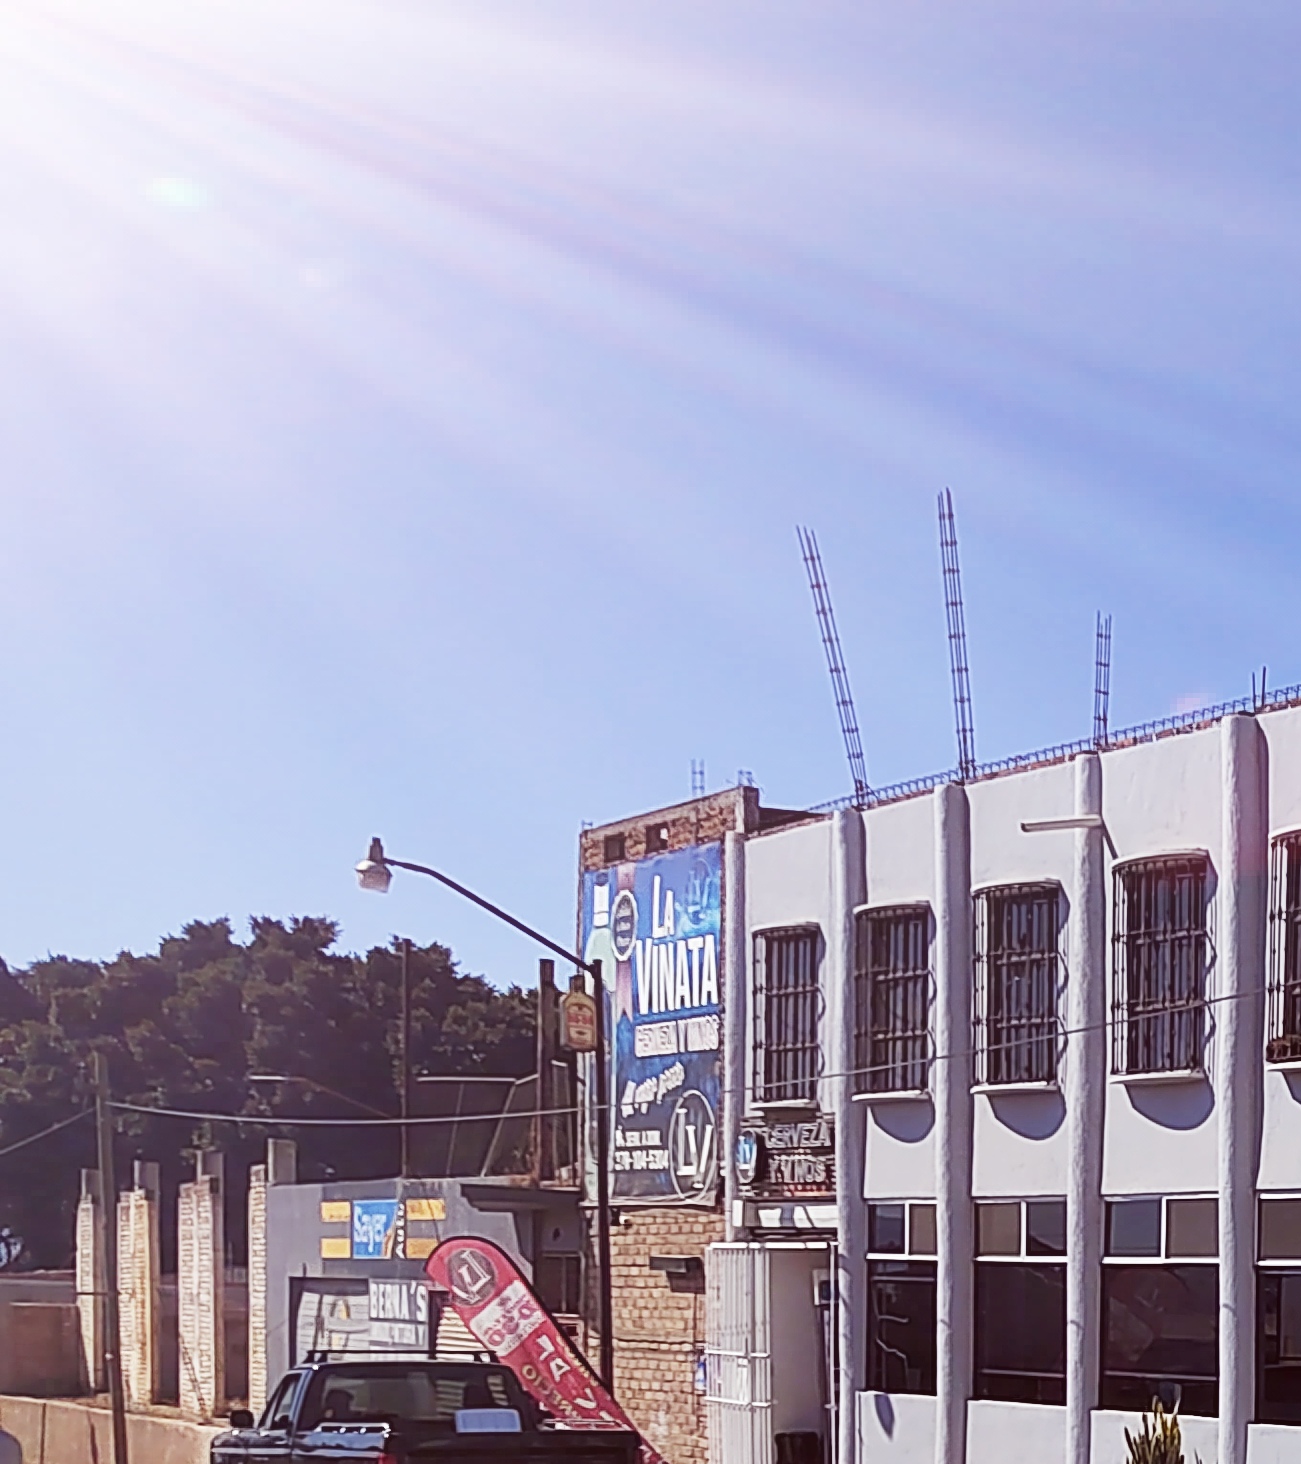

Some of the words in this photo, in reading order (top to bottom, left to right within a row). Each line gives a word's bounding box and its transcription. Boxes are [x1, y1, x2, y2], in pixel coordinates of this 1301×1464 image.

[652, 875, 675, 938] LA
[636, 934, 718, 1015] VINATA
[764, 1121, 831, 1149] CERVEZA
[768, 1158, 779, 1183] Y
[781, 1157, 826, 1183] VINOS
